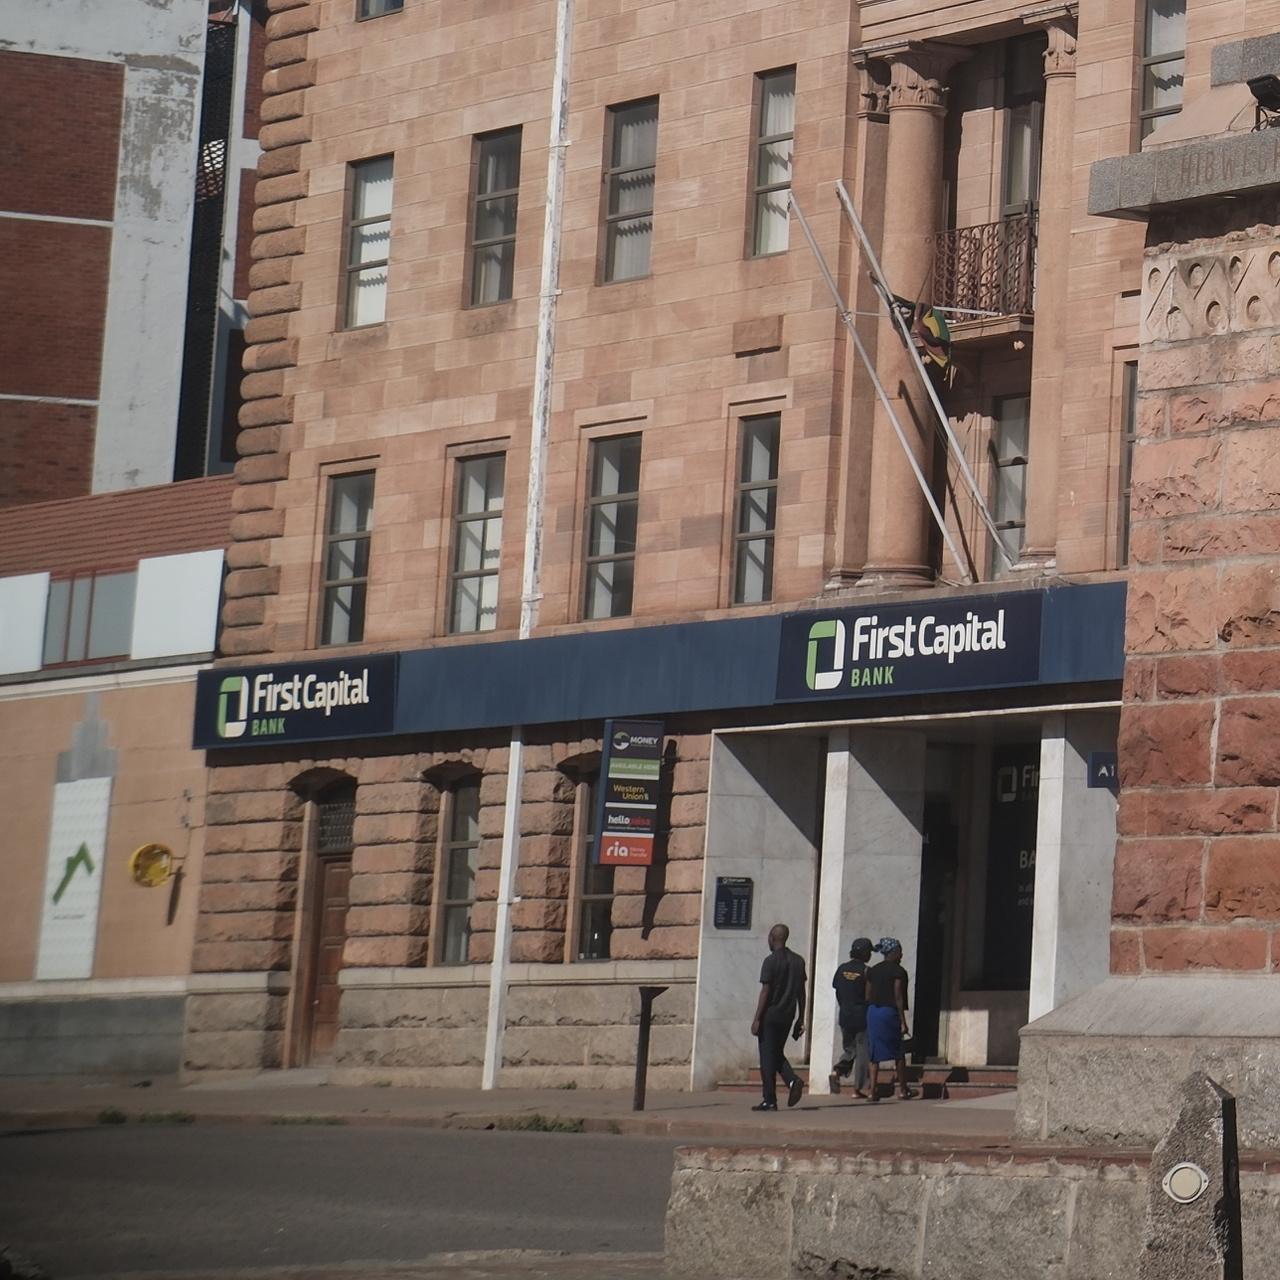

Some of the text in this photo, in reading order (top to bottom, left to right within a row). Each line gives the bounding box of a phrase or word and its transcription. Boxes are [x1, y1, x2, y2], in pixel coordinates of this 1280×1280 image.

[852, 609, 1006, 664] First Capital
[851, 666, 894, 687] BANK
[252, 668, 369, 716] First Capital
[252, 718, 286, 735] BANK
[630, 736, 659, 745] MONEY
[613, 784, 645, 793] Western
[622, 792, 644, 800] Union
[606, 841, 629, 857] ria
